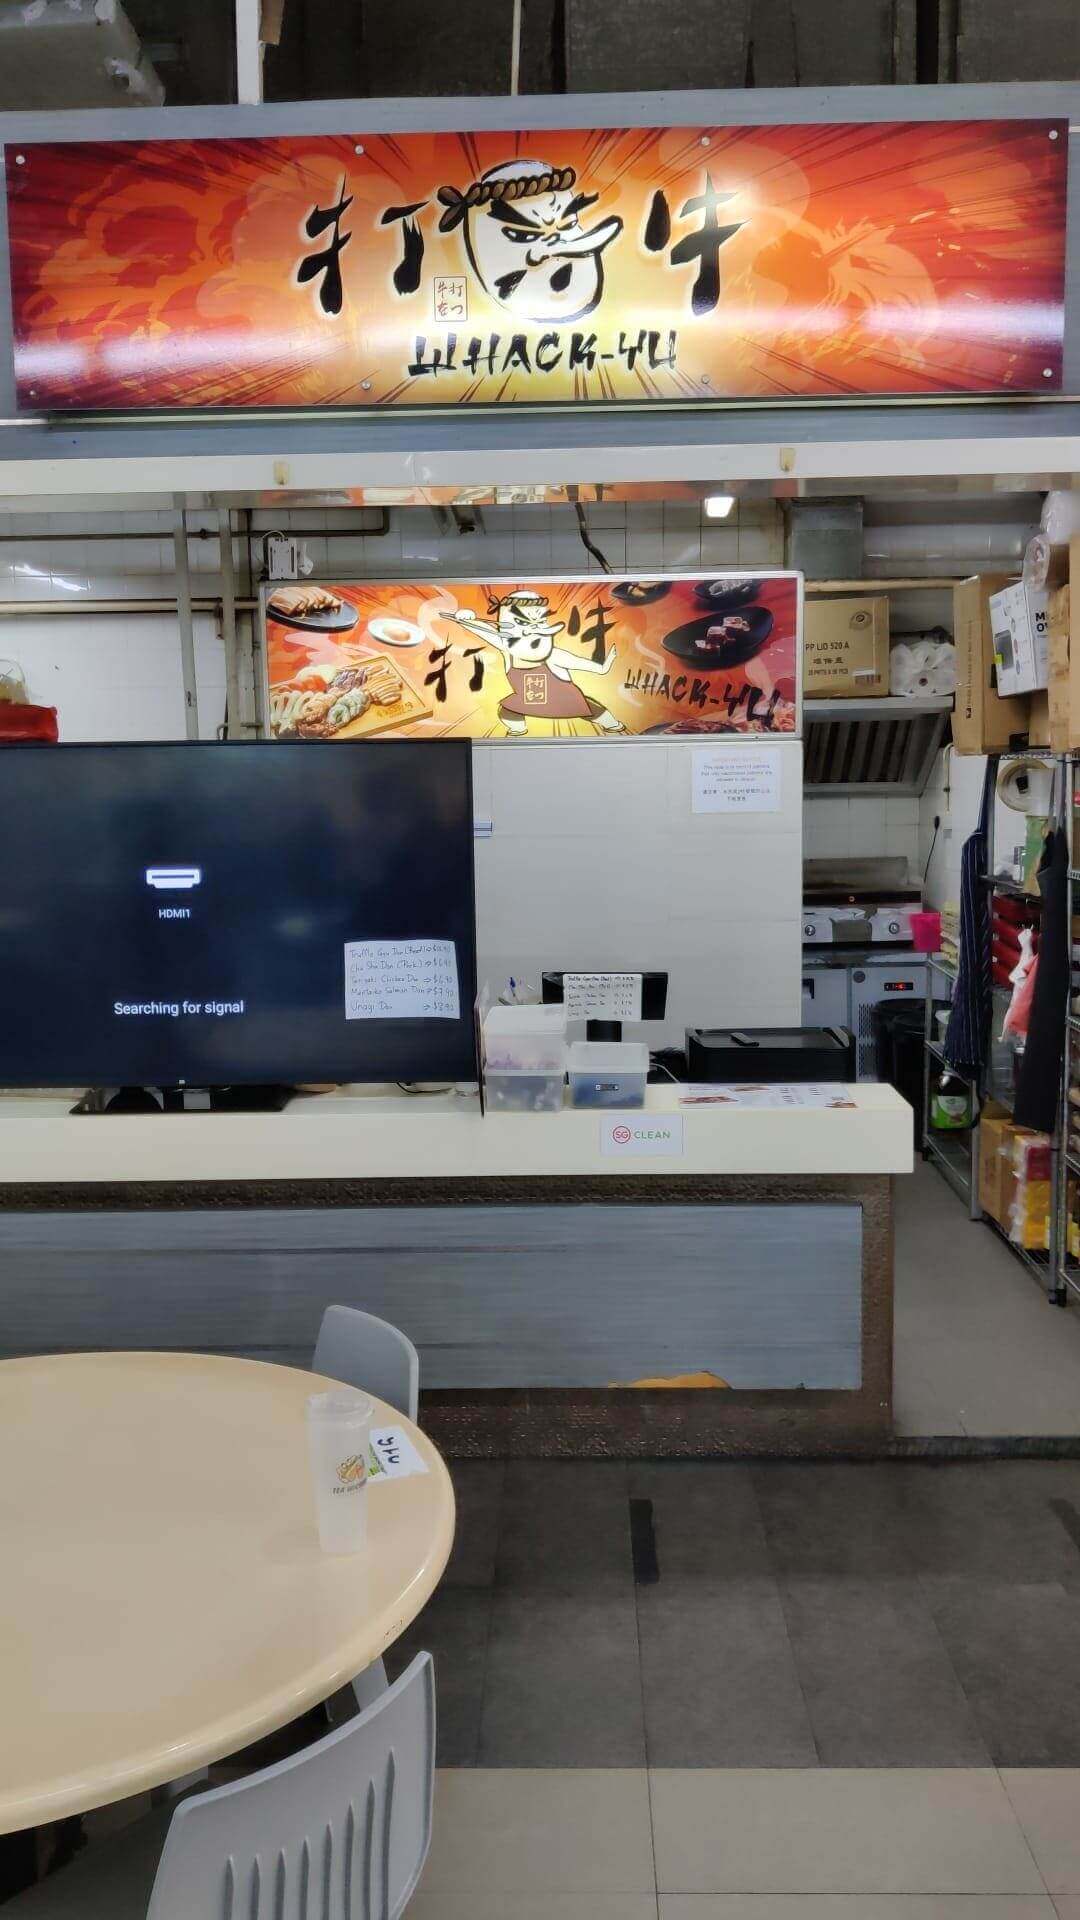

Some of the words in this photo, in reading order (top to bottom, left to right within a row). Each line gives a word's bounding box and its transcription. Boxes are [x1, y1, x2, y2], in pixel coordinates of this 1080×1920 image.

[645, 169, 752, 316] 牛
[158, 908, 191, 919] HDMI1
[114, 1002, 179, 1017] Searching
[182, 1001, 201, 1014] for
[204, 1000, 244, 1016] signal
[615, 1130, 628, 1139] SG
[633, 1130, 671, 1140] CLEAN
